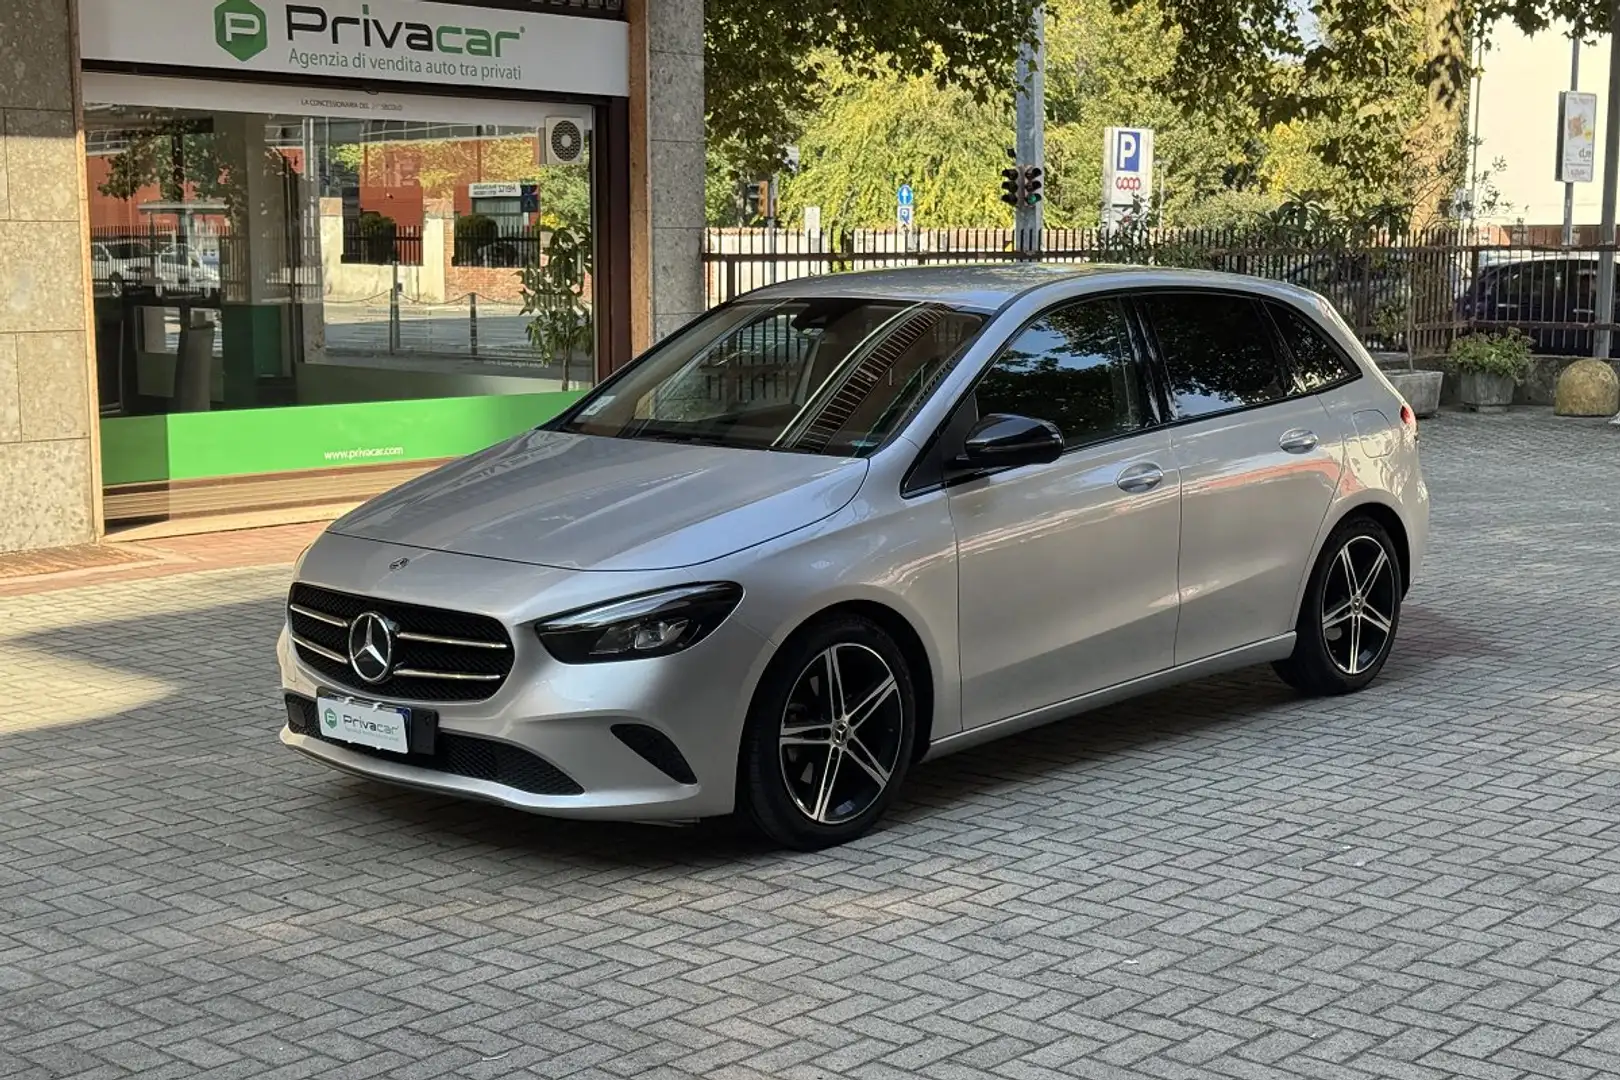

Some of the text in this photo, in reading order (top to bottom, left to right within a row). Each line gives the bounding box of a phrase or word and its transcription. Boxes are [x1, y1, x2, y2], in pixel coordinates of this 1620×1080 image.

[285, 4, 520, 58] Privacar
[289, 48, 521, 81] Agenzia di vendita auto tra privati
[1120, 134, 1136, 168] P
[324, 447, 404, 460] www.privacar.com
[343, 714, 400, 735] Privacar
